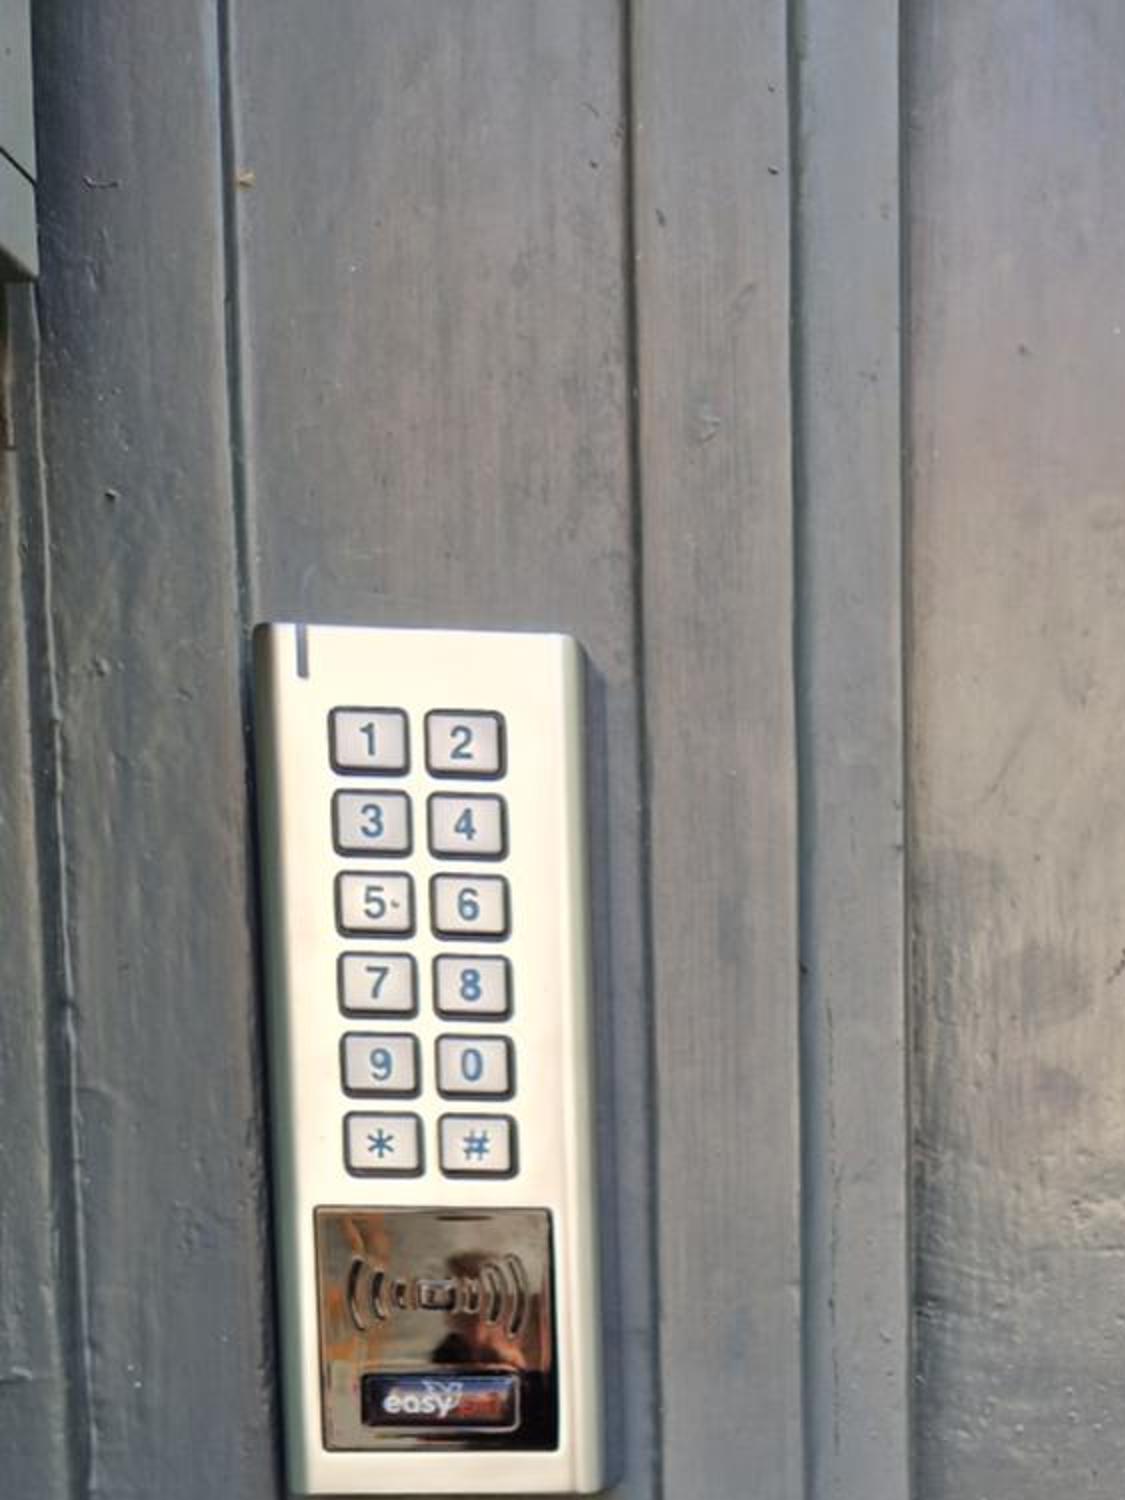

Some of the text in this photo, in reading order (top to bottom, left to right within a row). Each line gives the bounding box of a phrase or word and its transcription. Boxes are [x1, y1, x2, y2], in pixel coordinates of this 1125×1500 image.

[359, 722, 376, 756] 1
[450, 726, 473, 760] 2
[360, 803, 385, 838] 3
[454, 808, 476, 840] 4
[364, 886, 386, 918] 5
[457, 888, 479, 921] 6
[366, 966, 389, 999] 7
[459, 969, 481, 1001] 8
[370, 1048, 393, 1080] 9
[461, 1048, 482, 1081] 0
